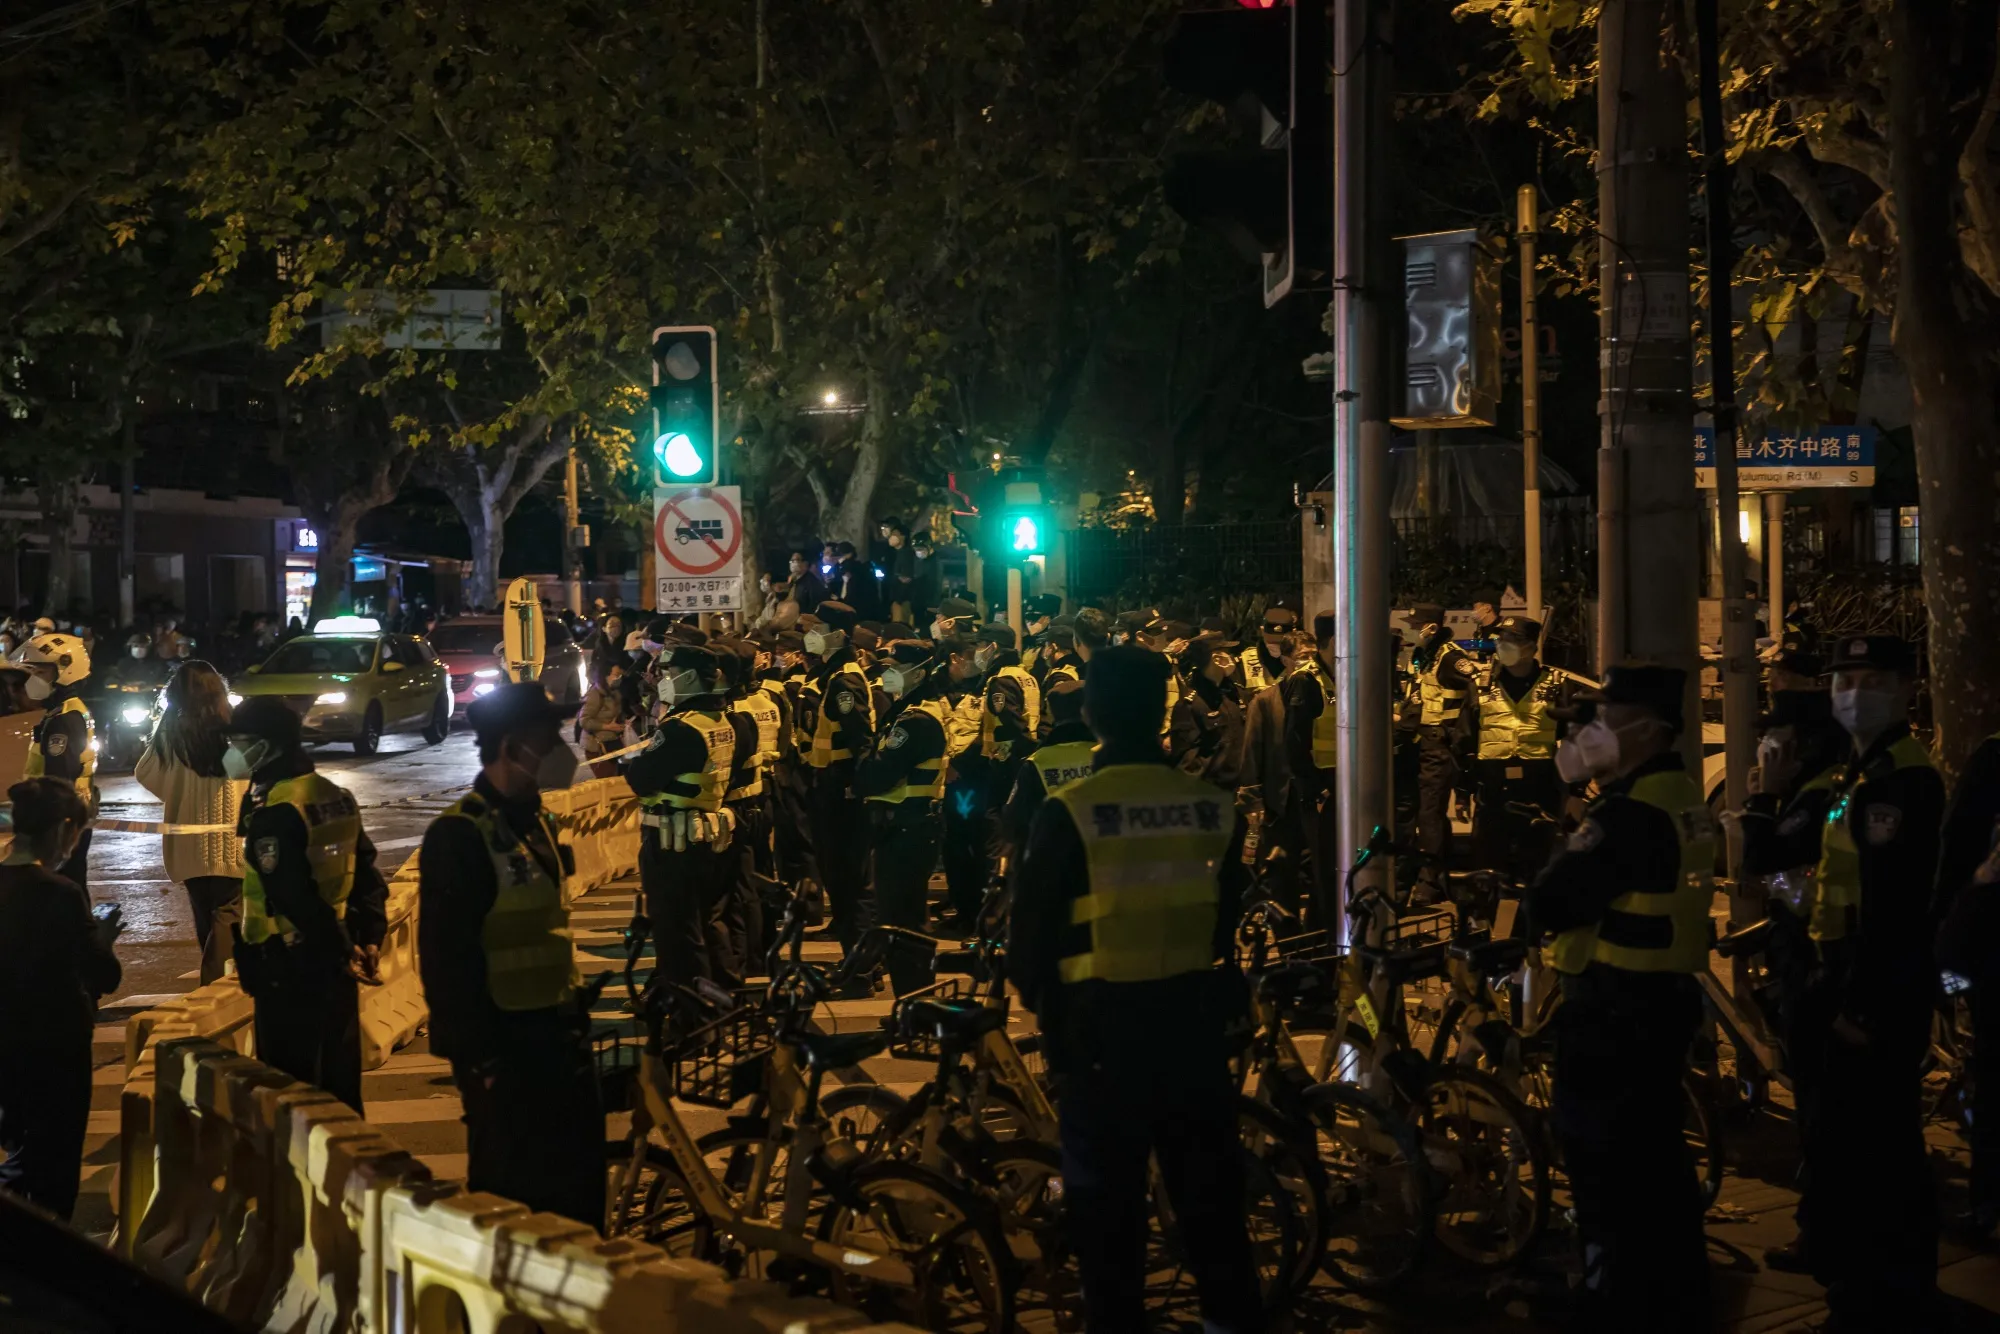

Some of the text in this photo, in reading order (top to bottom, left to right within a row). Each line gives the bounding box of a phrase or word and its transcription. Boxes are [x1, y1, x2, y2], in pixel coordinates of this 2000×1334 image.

[1735, 436, 1841, 459] 鲁木齐中路
[1846, 434, 1861, 449] 南
[1846, 451, 1860, 461] 99
[1849, 471, 1859, 483] S
[662, 580, 736, 593] 20:00-次日7:0
[1062, 765, 1092, 780] POLIC
[1128, 805, 1192, 829] POLICE
